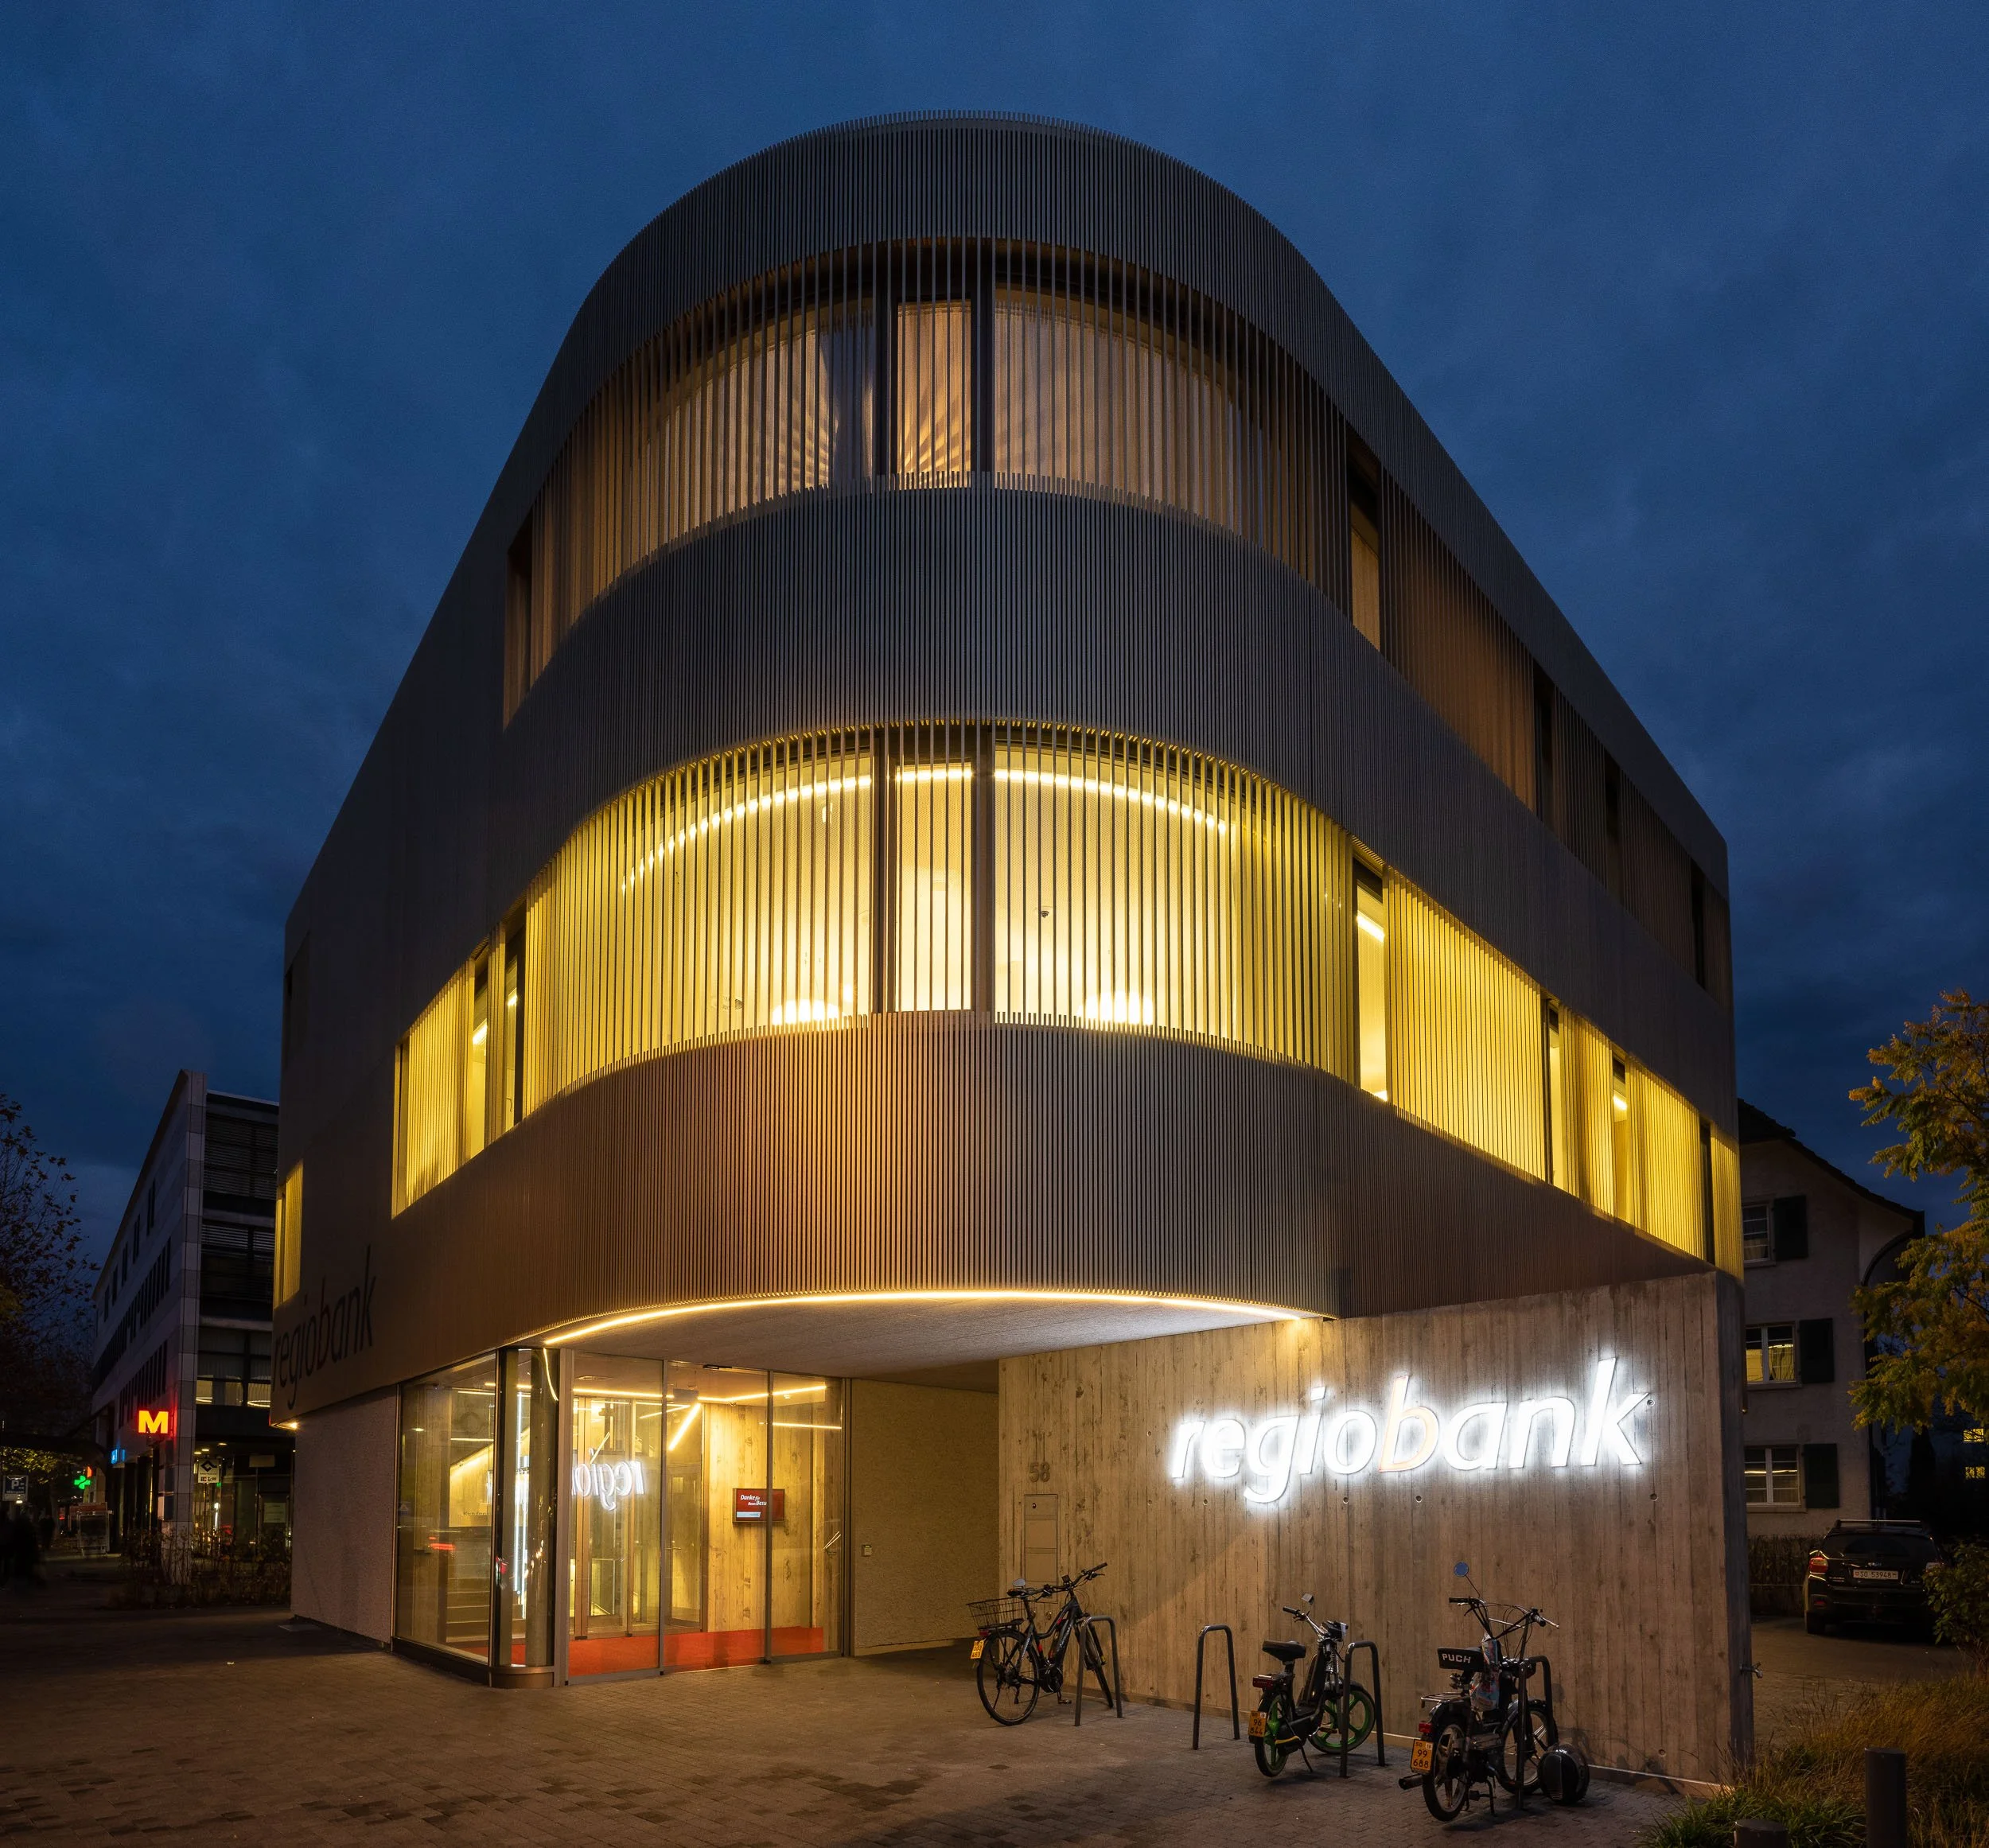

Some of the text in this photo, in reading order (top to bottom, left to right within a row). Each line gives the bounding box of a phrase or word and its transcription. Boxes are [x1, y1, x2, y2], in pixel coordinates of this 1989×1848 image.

[272, 1244, 376, 1410] regiobank
[138, 1410, 169, 1434] M
[1172, 1356, 1648, 1503] regiobank
[1029, 1462, 1050, 1482] 58
[11, 1480, 20, 1490] P
[1442, 1653, 1471, 1663] PUCH
[1418, 1749, 1427, 1758] 99
[1413, 1759, 1428, 1768] 688
